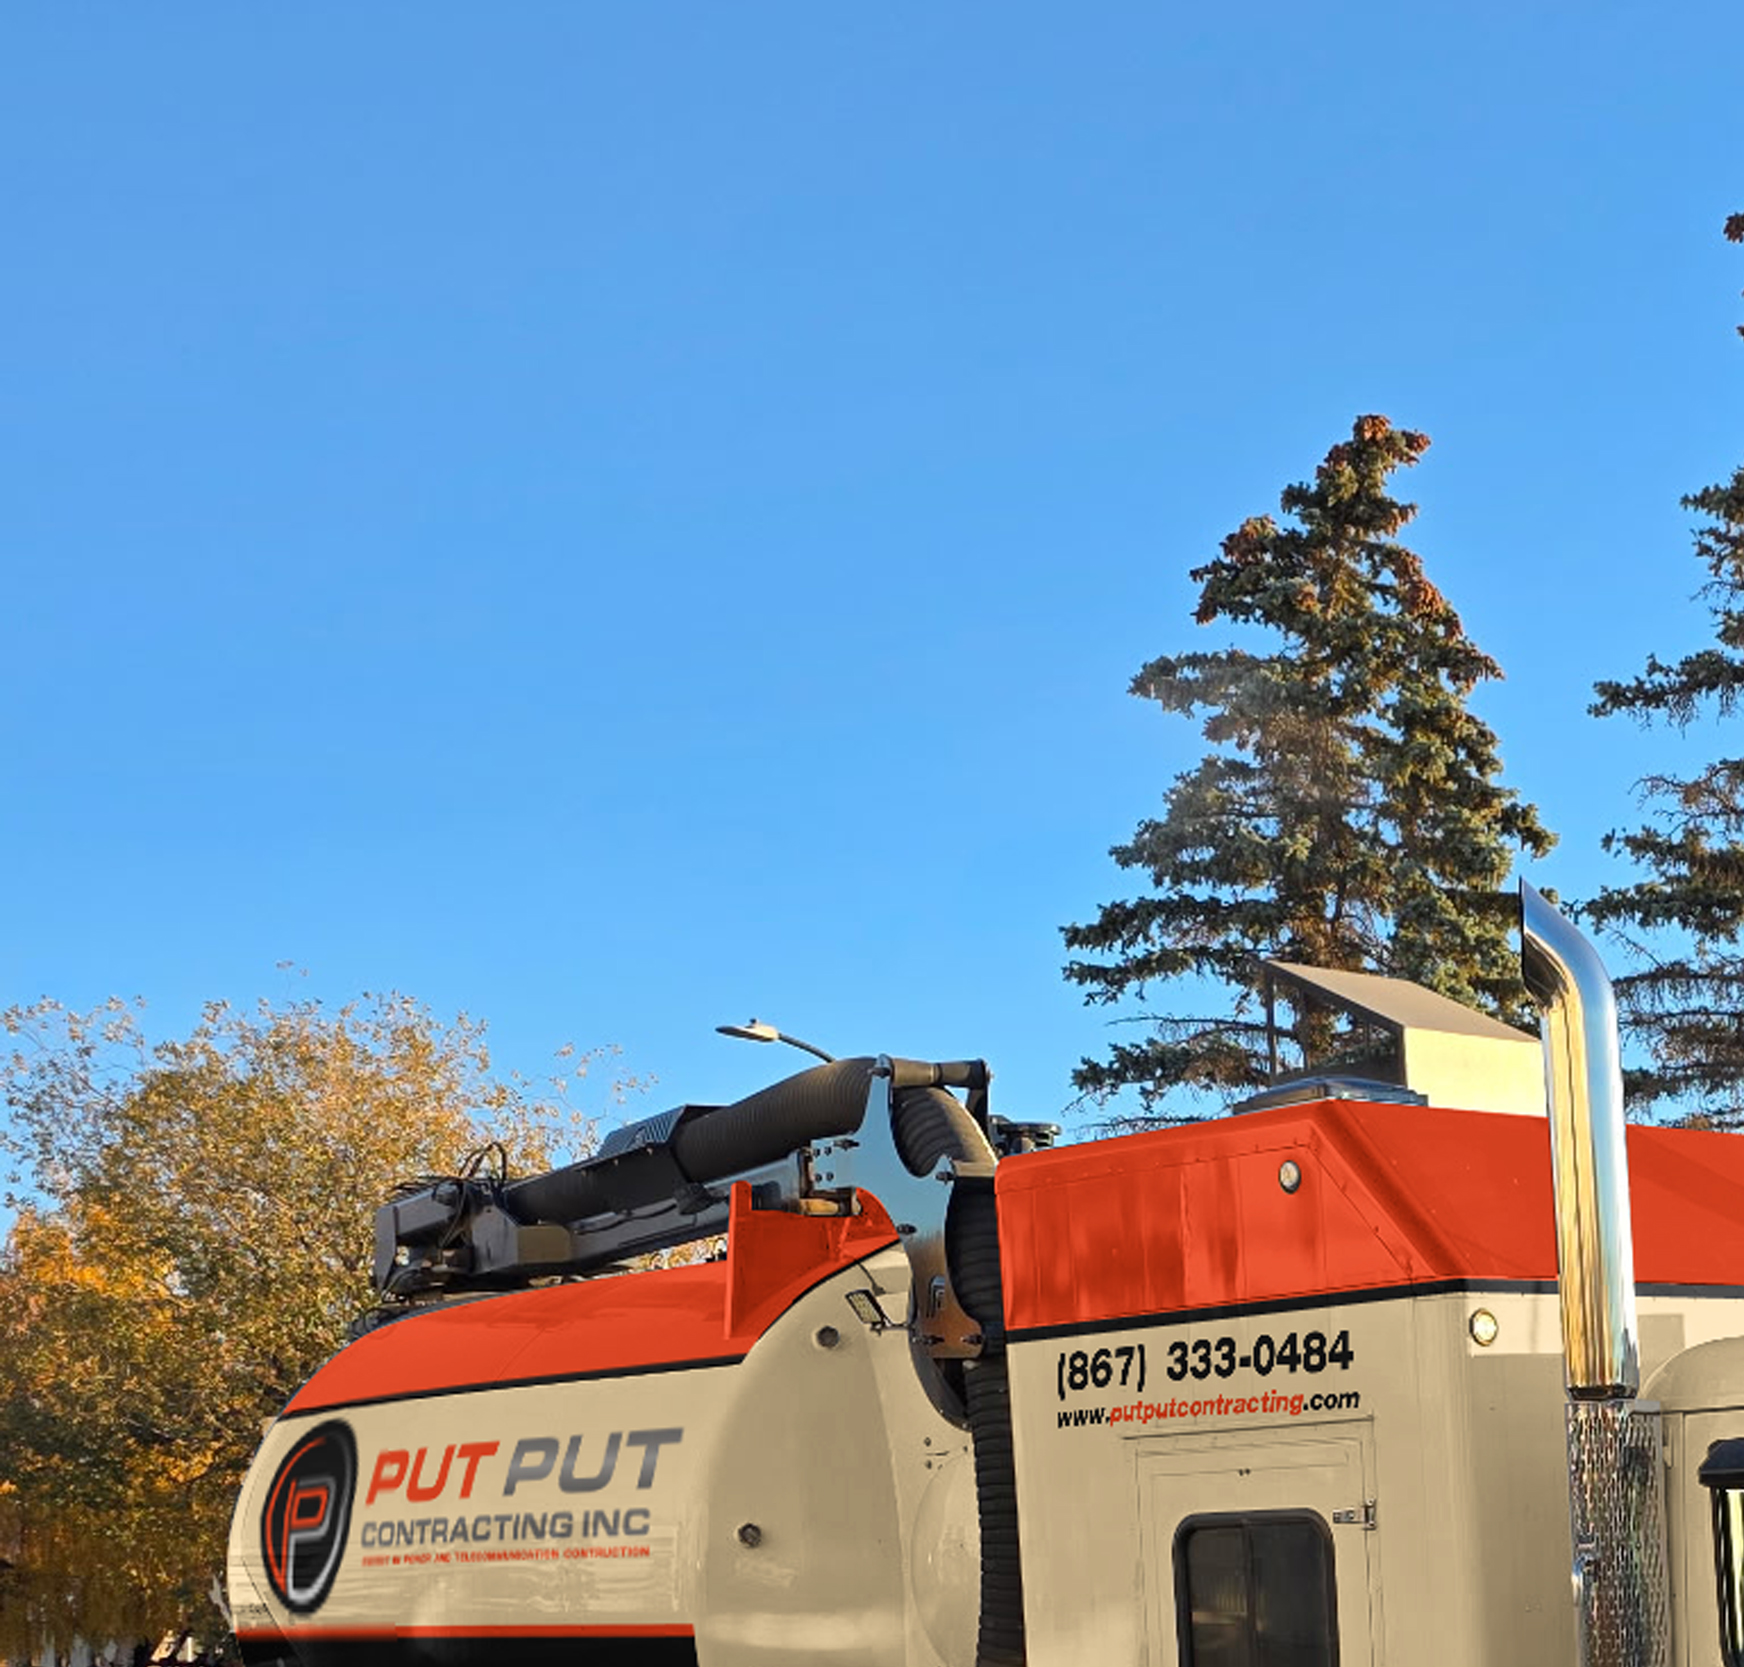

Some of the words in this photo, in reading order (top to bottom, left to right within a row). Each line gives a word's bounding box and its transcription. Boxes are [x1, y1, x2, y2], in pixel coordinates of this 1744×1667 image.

[1057, 1344, 1145, 1401] (867)
[1166, 1330, 1354, 1381] 333-0484
[1057, 1389, 1360, 1428] www.putputcontracting.com
[366, 1440, 499, 1506] PUT
[503, 1427, 683, 1497] PUT
[361, 1511, 573, 1548] CONTRACTING
[582, 1508, 651, 1538] INC
